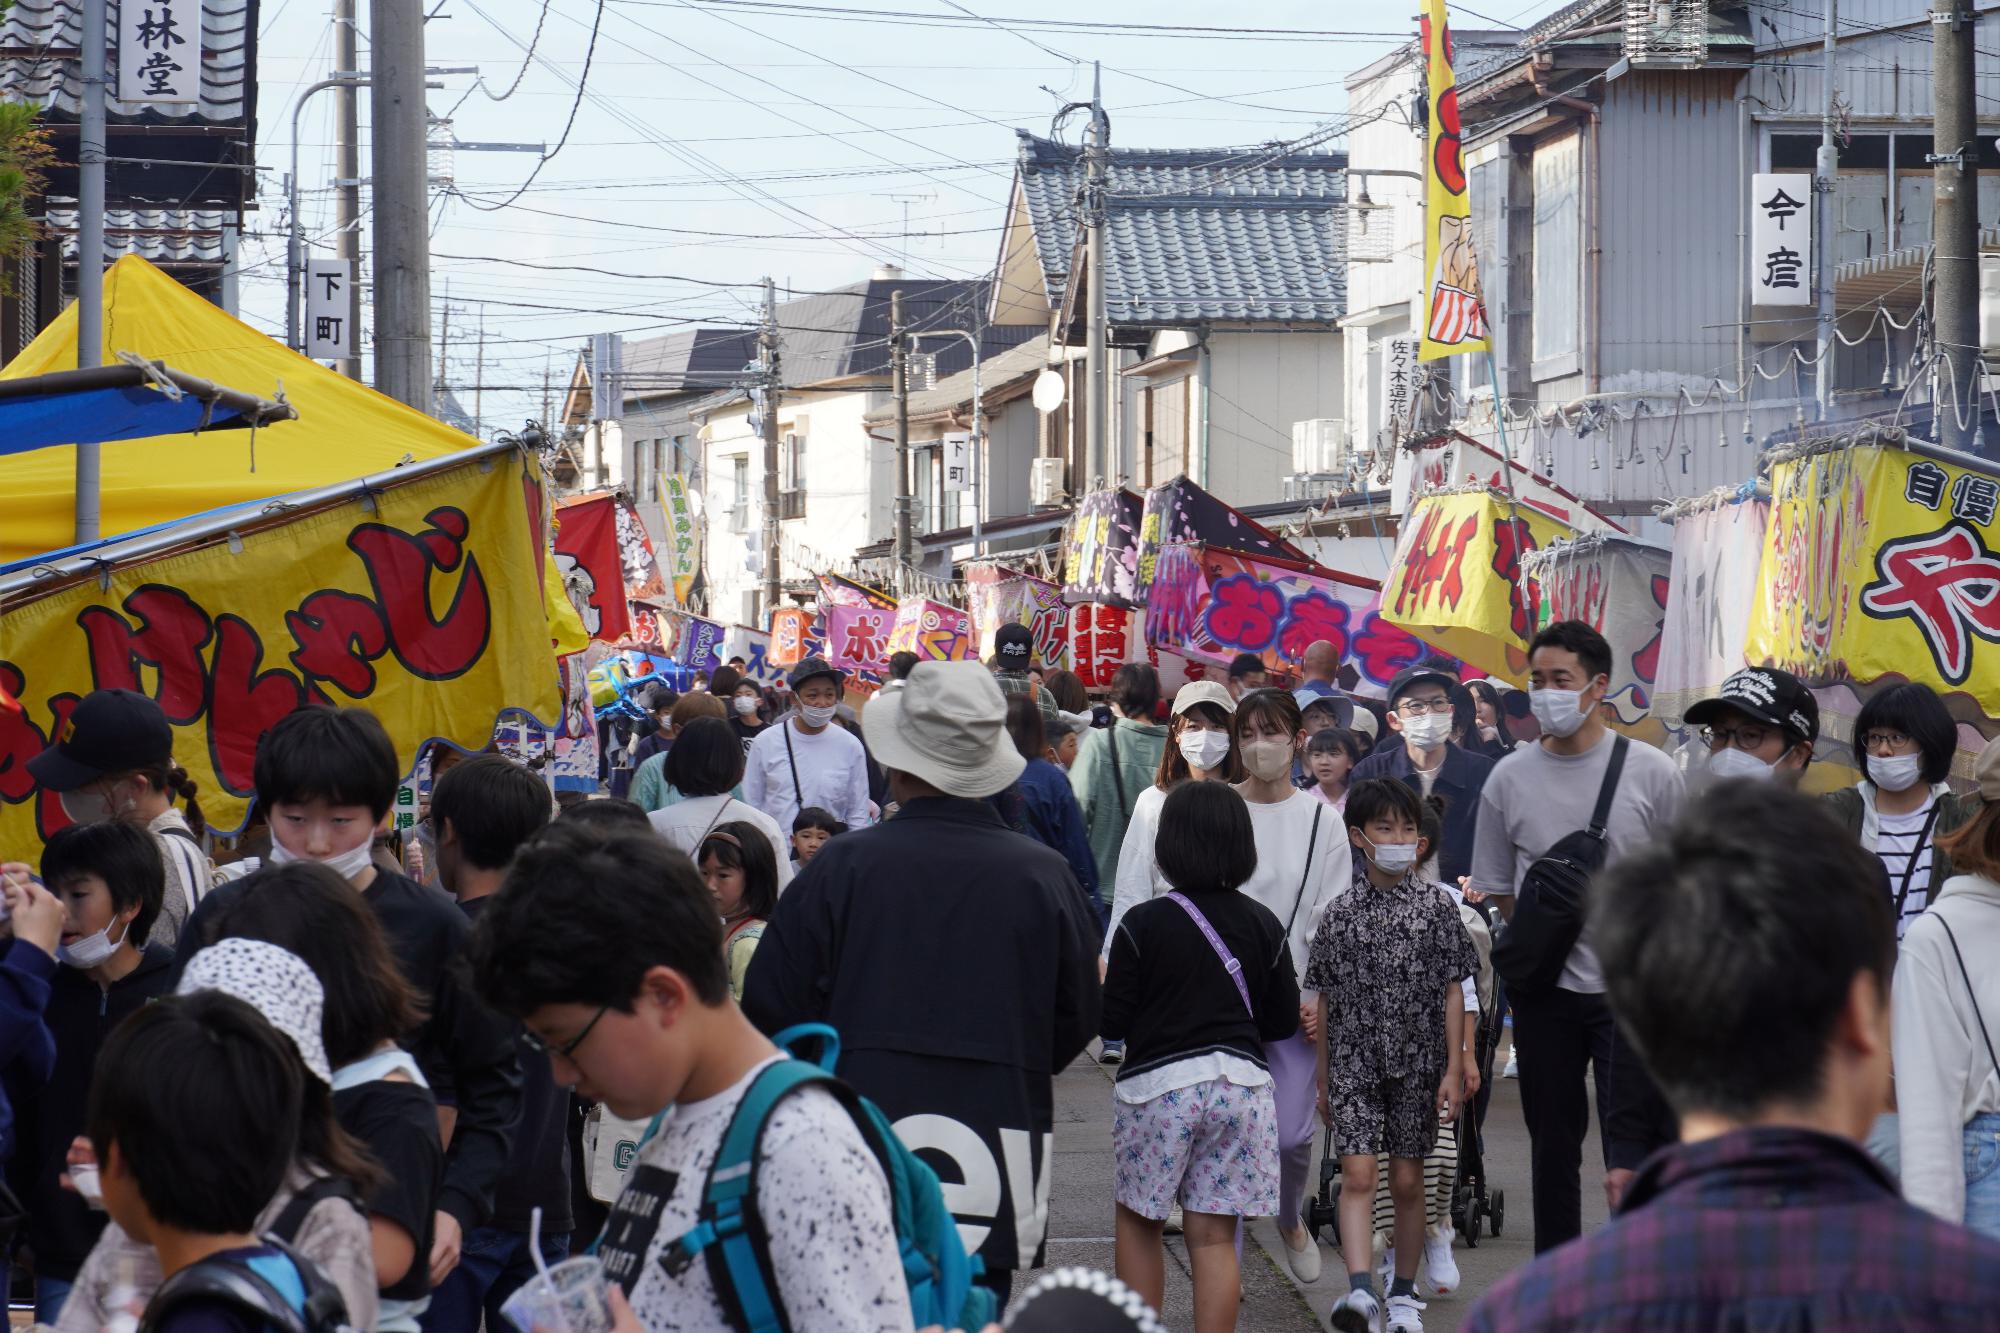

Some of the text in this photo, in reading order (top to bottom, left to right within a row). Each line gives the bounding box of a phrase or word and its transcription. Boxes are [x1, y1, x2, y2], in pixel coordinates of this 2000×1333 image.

[135, 0, 186, 95] 林堂
[1761, 188, 1804, 288] 今彦
[315, 271, 343, 345] 下町
[949, 439, 965, 483] 下町
[1904, 461, 2000, 527] 自慢
